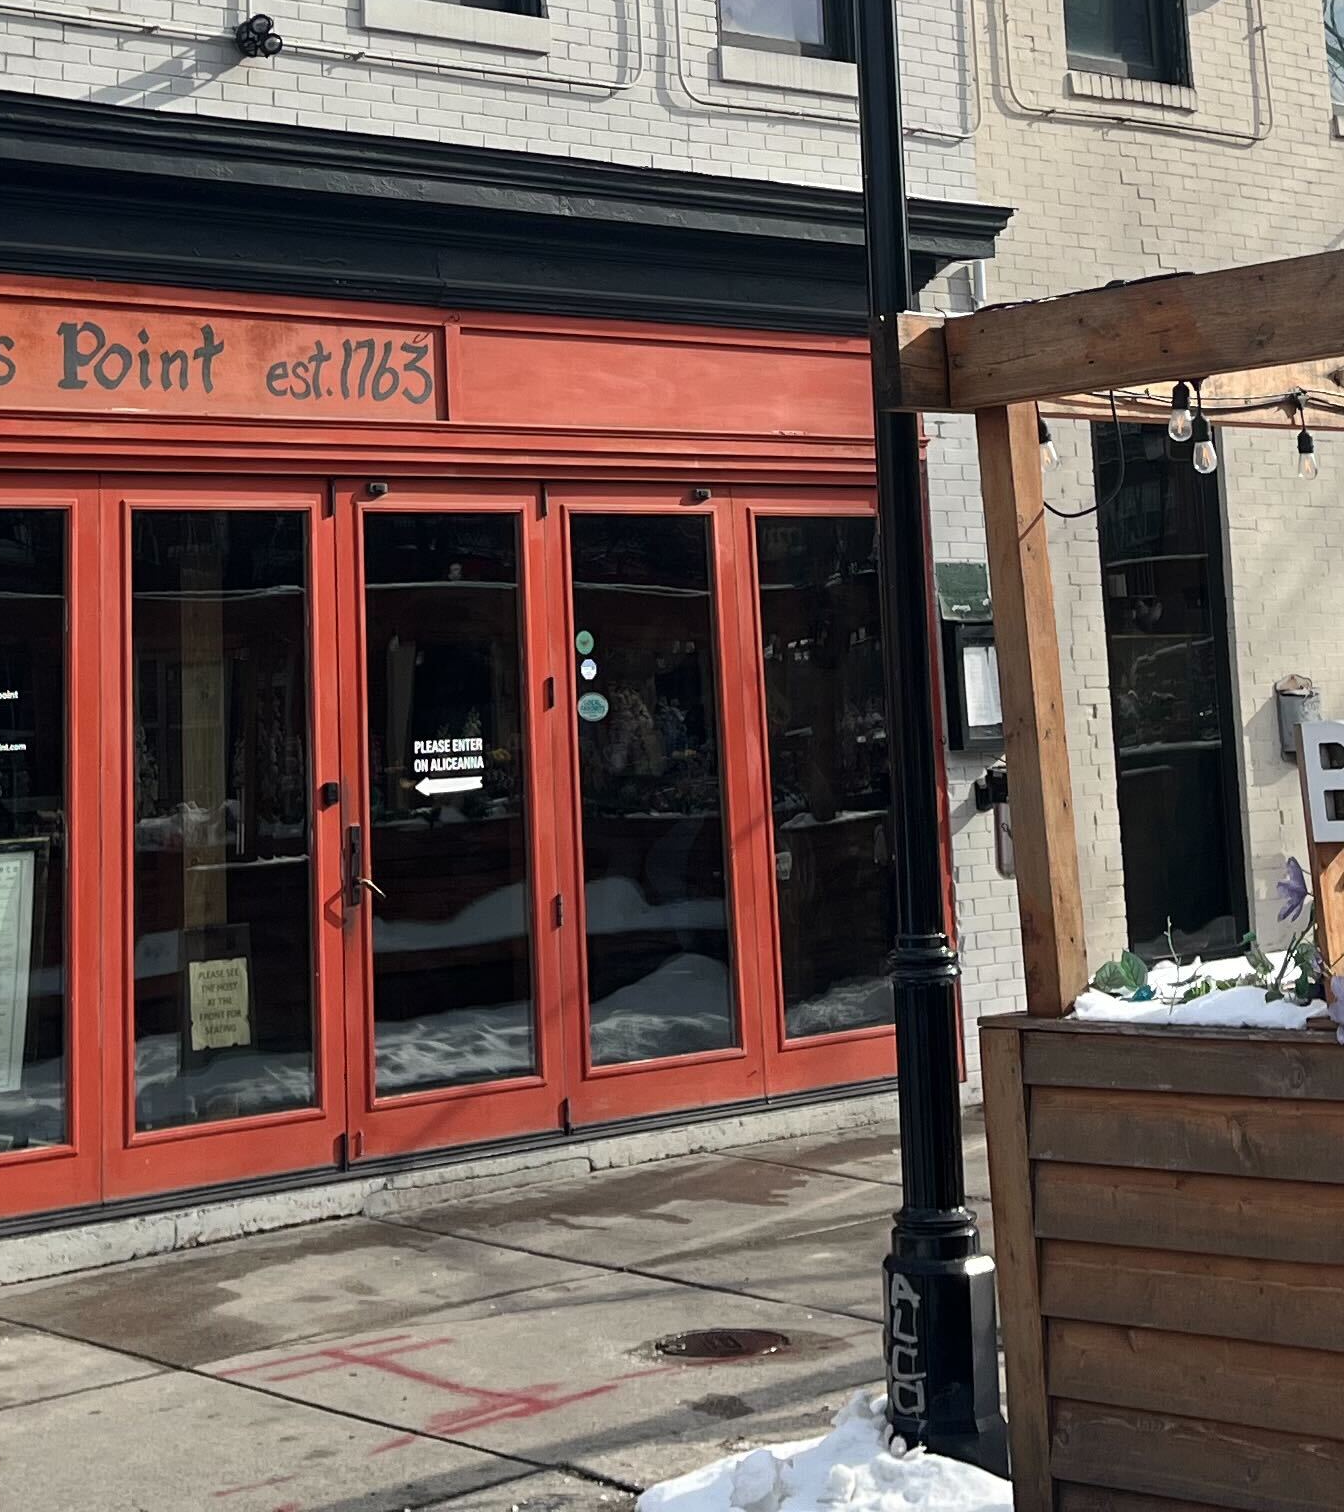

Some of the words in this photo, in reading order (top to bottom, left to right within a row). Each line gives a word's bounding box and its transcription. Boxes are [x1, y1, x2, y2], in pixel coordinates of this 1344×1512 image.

[57, 321, 225, 394] Point
[414, 739, 451, 754] PLEASE
[452, 737, 483, 753] ENTER
[414, 759, 429, 772] ON
[430, 755, 485, 772] ALICEANNA
[198, 970, 224, 979] PLEASE
